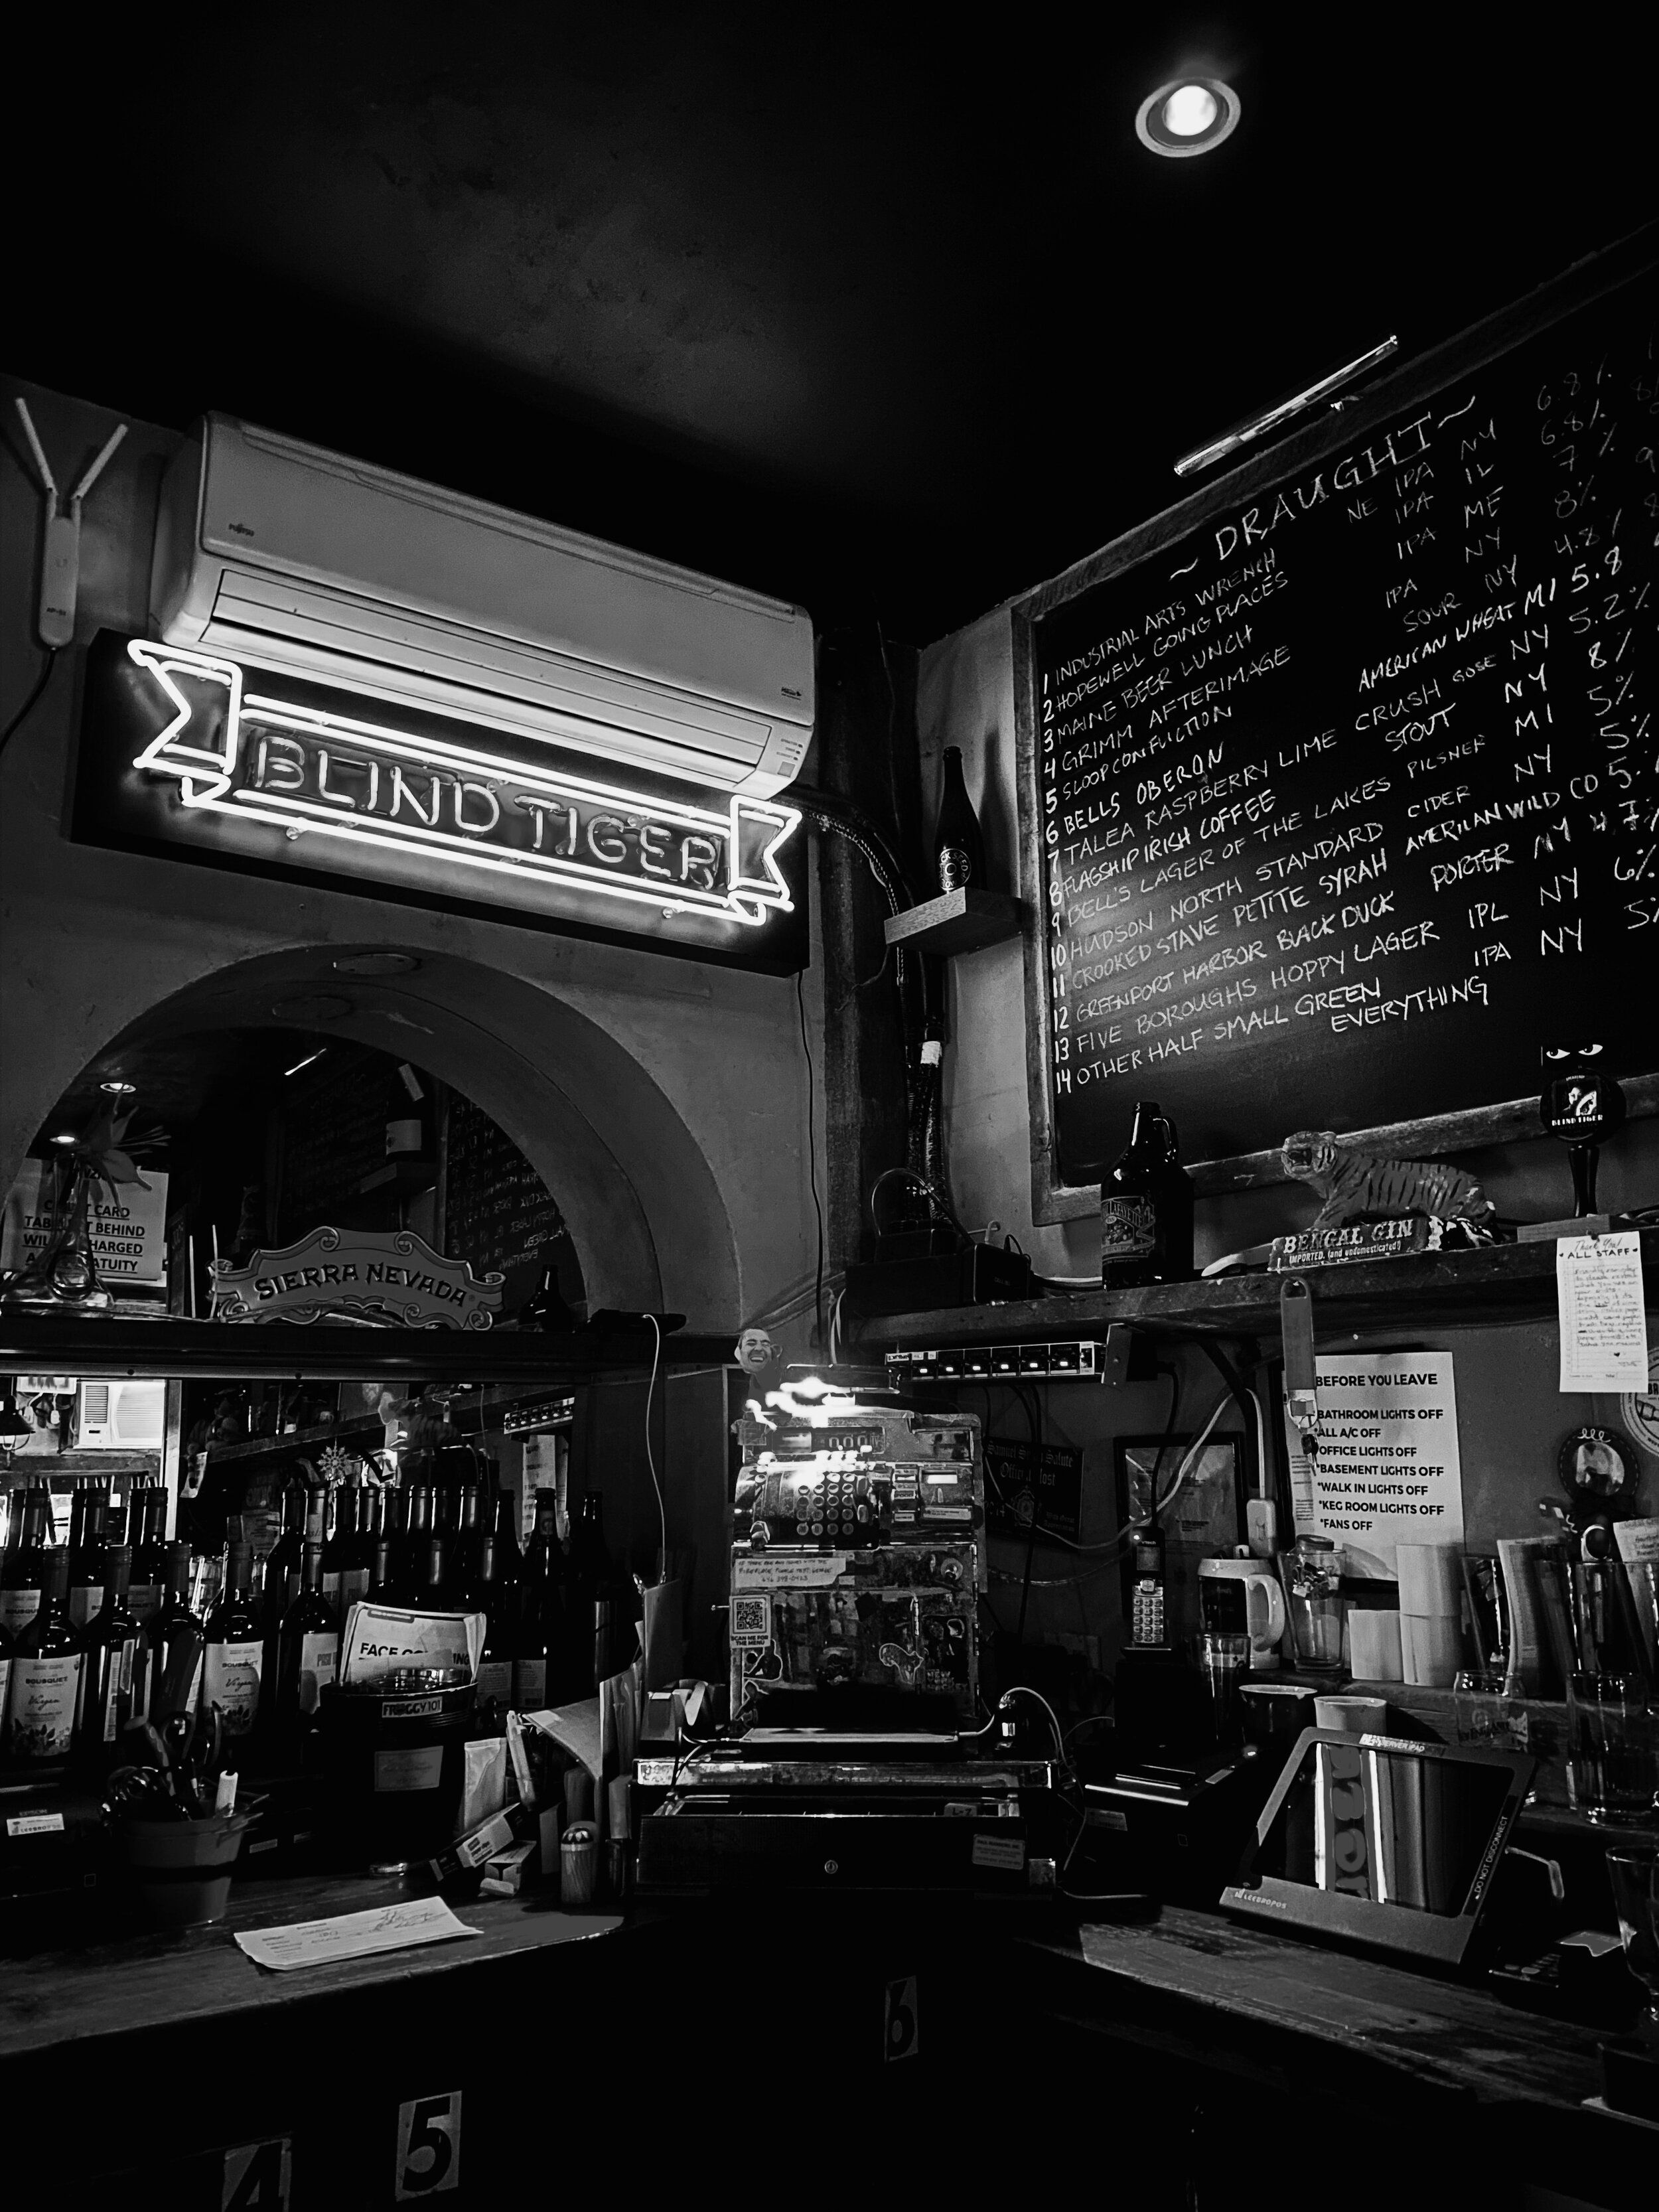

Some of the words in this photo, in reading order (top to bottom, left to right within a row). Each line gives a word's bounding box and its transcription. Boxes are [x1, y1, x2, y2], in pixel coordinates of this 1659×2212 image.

[1216, 411, 1431, 560] DRAUGHT
[1044, 673, 1048, 694] 1
[1056, 628, 1140, 686] INDUSTRIAL
[1145, 600, 1186, 635] ARTS
[1195, 548, 1275, 605] WRENCH
[1347, 498, 1378, 524] NE
[1395, 462, 1434, 497] IPA
[1461, 417, 1496, 461] NY
[1043, 699, 1054, 723] 2
[1056, 653, 1146, 711] HOPEWELL
[1153, 617, 1211, 656] GOING
[1216, 571, 1288, 623] PLACES
[1395, 491, 1434, 524] IPA
[1465, 464, 1494, 484] IL
[1044, 728, 1054, 753] 3
[1058, 700, 1118, 744] MAINE
[1121, 666, 1173, 709] BEER
[1181, 625, 1253, 677] LUNCH
[1397, 527, 1437, 560] IPA
[1464, 485, 1504, 528] ME
[1044, 758, 1056, 780] 4
[1062, 724, 1133, 771] GRIMM
[1149, 645, 1291, 729] AFTERIMAGE
[1384, 579, 1418, 608] IPA
[1465, 527, 1500, 563] NY
[1046, 788, 1057, 814] 5
[1062, 763, 1110, 801] SLOOP
[1113, 705, 1232, 774] CONFLICTION
[1403, 592, 1463, 632] SOUR
[1485, 554, 1517, 593] NY
[1046, 820, 1058, 844] 6
[1064, 792, 1120, 835] BELLS
[1137, 741, 1224, 805] OBERON
[1359, 634, 1447, 693] AMERICAN
[1456, 601, 1518, 642] WHEAT
[1525, 577, 1556, 615] MI
[1048, 849, 1059, 874] 7
[1063, 822, 1135, 865] TALEA
[1145, 760, 1268, 830] RASPBERRY
[1279, 729, 1338, 768] LIME
[1355, 678, 1441, 731] CRUSH
[1510, 623, 1549, 660] NY
[1049, 881, 1062, 906] 8
[1062, 848, 1139, 898] FLAGSHIP
[1144, 827, 1190, 863] IRISH
[1200, 789, 1276, 840] COFFEE
[1385, 701, 1457, 752] STOUT
[1505, 662, 1548, 703] NY
[255, 735, 499, 834] BLIND
[514, 794, 716, 890] TIGER
[1052, 912, 1061, 937] 9
[1068, 885, 1131, 928] BELL'S
[1140, 849, 1214, 893] LAGER
[1222, 838, 1246, 859] OF
[1254, 812, 1303, 842] THE
[1315, 776, 1391, 820] LAKES
[1407, 734, 1486, 779] PILSNER
[1515, 702, 1553, 737] MI
[1051, 943, 1067, 971] 10
[1070, 910, 1153, 960] HUDSON
[1171, 877, 1242, 922] NORTH
[1256, 822, 1384, 881] STANDARD
[1407, 784, 1471, 818] CIDER
[1514, 743, 1551, 784] NY
[1052, 974, 1066, 998] 11
[1072, 944, 1151, 989] CROOKED
[1156, 914, 1220, 954] STAVE
[1232, 886, 1311, 927] PETITE
[1319, 848, 1388, 896] SYRAH
[1505, 792, 1560, 819] WILD
[1570, 774, 1599, 800] CO
[1054, 1006, 1069, 1033] 12
[1076, 972, 1175, 1022] GREENPORT
[1183, 940, 1267, 984] HARBOR
[1277, 913, 1336, 951] BLACK
[1341, 890, 1394, 928] DUCK
[1430, 843, 1514, 892] PORTER
[1475, 941, 1512, 966] IPA
[1542, 917, 1583, 956] NY
[1054, 1037, 1069, 1063] 13
[1076, 1025, 1122, 1053] FIVE
[1137, 978, 1257, 1034] BOROUGHS
[1271, 950, 1344, 989] HOPPY
[1354, 921, 1440, 962] LAGER
[1469, 903, 1509, 929] IPL
[1540, 866, 1578, 906] NY
[1295, 977, 1381, 1015] GREEN
[1331, 975, 1488, 1033] EVERYTHING
[1148, 1029, 1203, 1063] HALF
[1214, 1004, 1289, 1040] SMALL
[1056, 1068, 1072, 1094] 14
[1076, 1049, 1143, 1085] OTHER
[89, 1240, 143, 1254] HARGED
[96, 1222, 145, 1236] BEHIND
[1283, 1228, 1363, 1254] BENGAL
[1371, 1219, 1413, 1241] GIN
[1567, 1250, 1591, 1259] ALL
[1597, 1248, 1629, 1257] STAFF
[255, 1264, 359, 1301] SIERRA
[366, 1262, 467, 1307] NEVADA
[1316, 1375, 1365, 1386] BEFORE
[1368, 1375, 1392, 1386] YOU
[1394, 1374, 1437, 1385] LEAVE
[1317, 1410, 1378, 1420] BATHROOM
[1380, 1410, 1415, 1419] LIGHTS
[1417, 1410, 1443, 1419] OFF
[1340, 1427, 1358, 1438] A/C
[1360, 1428, 1381, 1438] OFF
[1319, 1446, 1356, 1455] OFFICE
[1359, 1446, 1394, 1456] LIGHTS
[1396, 1447, 1417, 1457] OFF
[1380, 1466, 1416, 1475] LIGHTS
[1418, 1467, 1444, 1476] OFF
[1345, 1502, 1377, 1512] ROOM
[1380, 1504, 1417, 1514] LIGHTS
[1419, 1505, 1444, 1514] OFF
[1354, 1483, 1365, 1493] IN
[1368, 1485, 1404, 1494] LIGHTS
[1406, 1486, 1428, 1495] OFF
[1352, 1520, 1372, 1530] OFF
[1474, 1881, 1484, 1892] DO
[1479, 1863, 1490, 1880] NOT
[1485, 1816, 1508, 1863] DISCONNECT
[889, 1980, 915, 2057] 6
[402, 2096, 452, 2191] 5
[224, 2139, 284, 2212] 4
